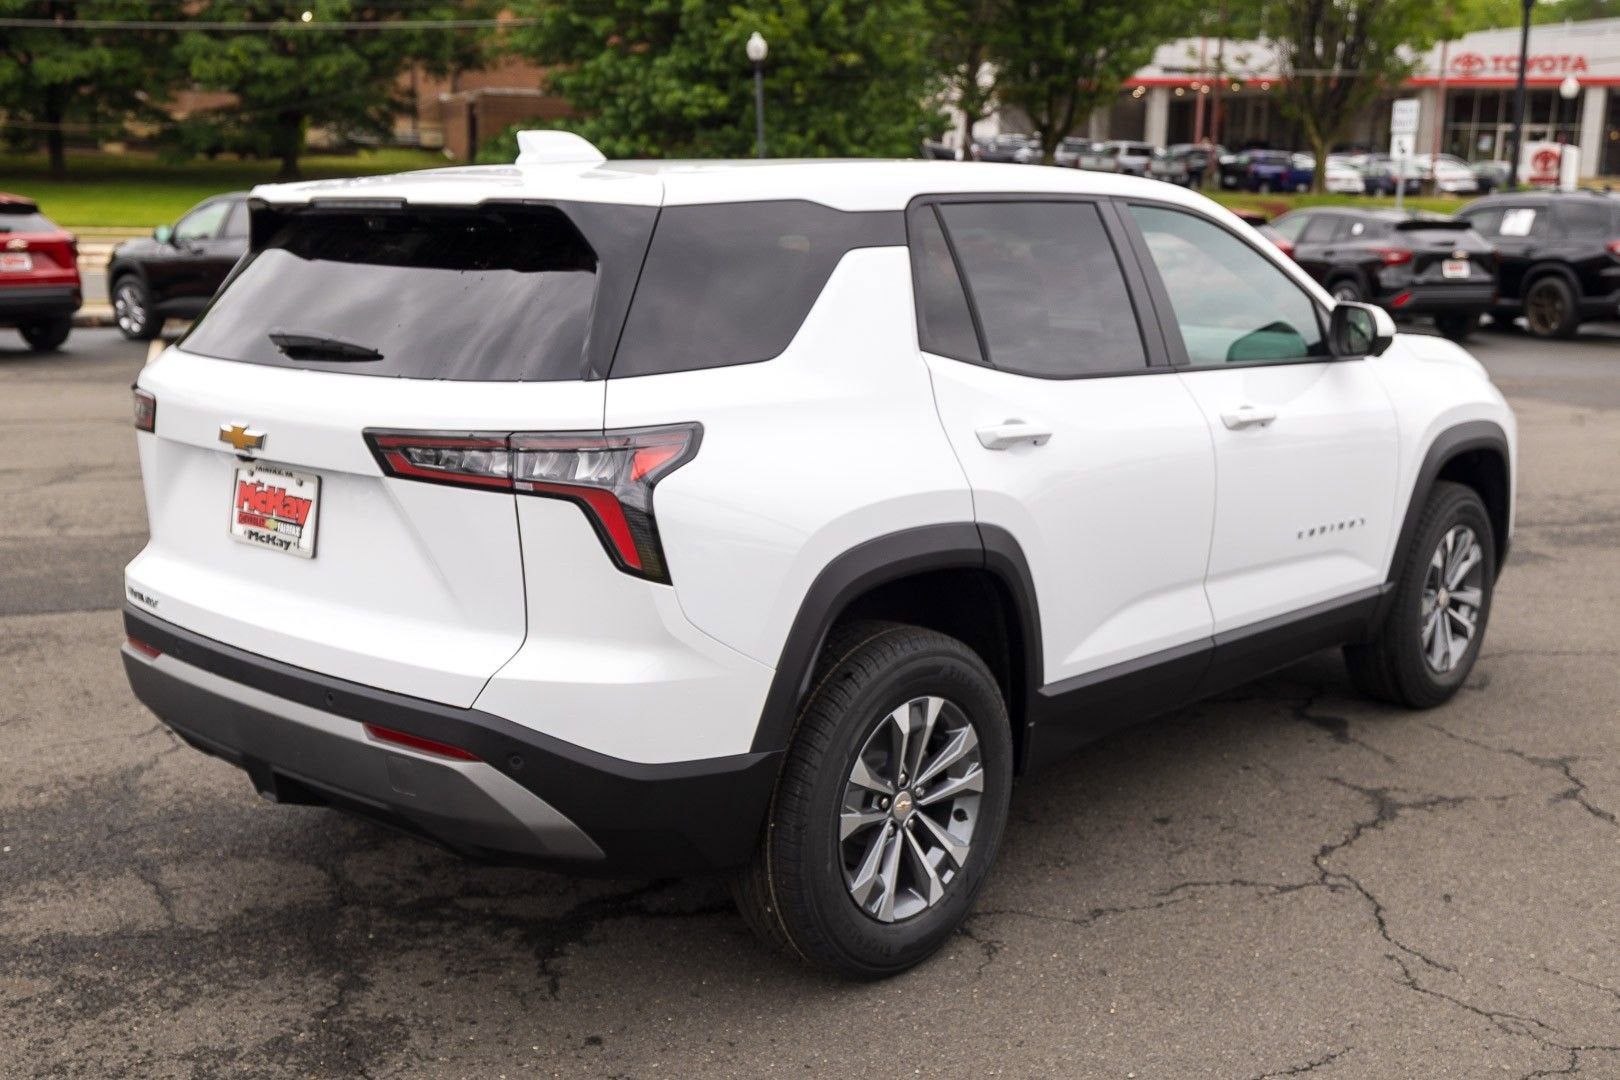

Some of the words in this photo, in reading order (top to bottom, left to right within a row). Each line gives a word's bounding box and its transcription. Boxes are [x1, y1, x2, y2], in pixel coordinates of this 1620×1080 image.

[1491, 54, 1588, 73] TOYOTA
[237, 480, 312, 526] McKay
[248, 530, 291, 550] McKay
